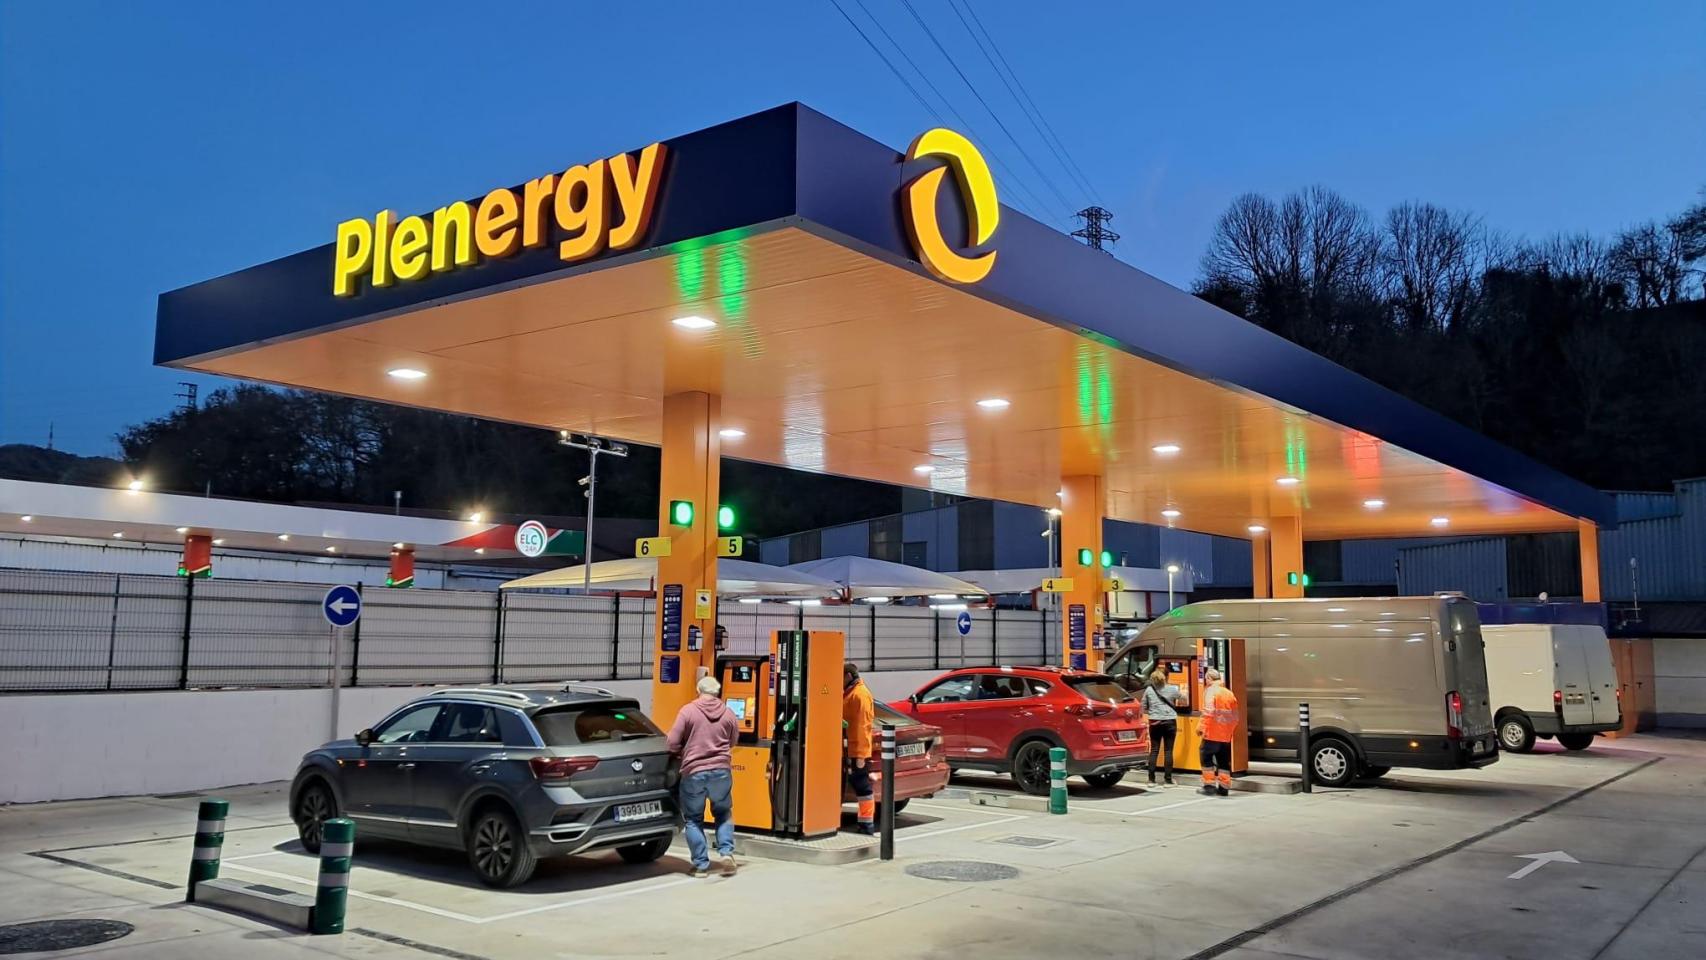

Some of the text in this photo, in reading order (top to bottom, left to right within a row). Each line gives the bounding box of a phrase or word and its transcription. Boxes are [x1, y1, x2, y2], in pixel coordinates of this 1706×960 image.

[334, 142, 667, 296] Plenergy
[520, 534, 537, 545] ELC
[729, 539, 737, 553] 5
[641, 541, 649, 555] 6
[1046, 580, 1053, 590] 4
[1112, 580, 1119, 590] 3
[621, 804, 642, 817] 3993
